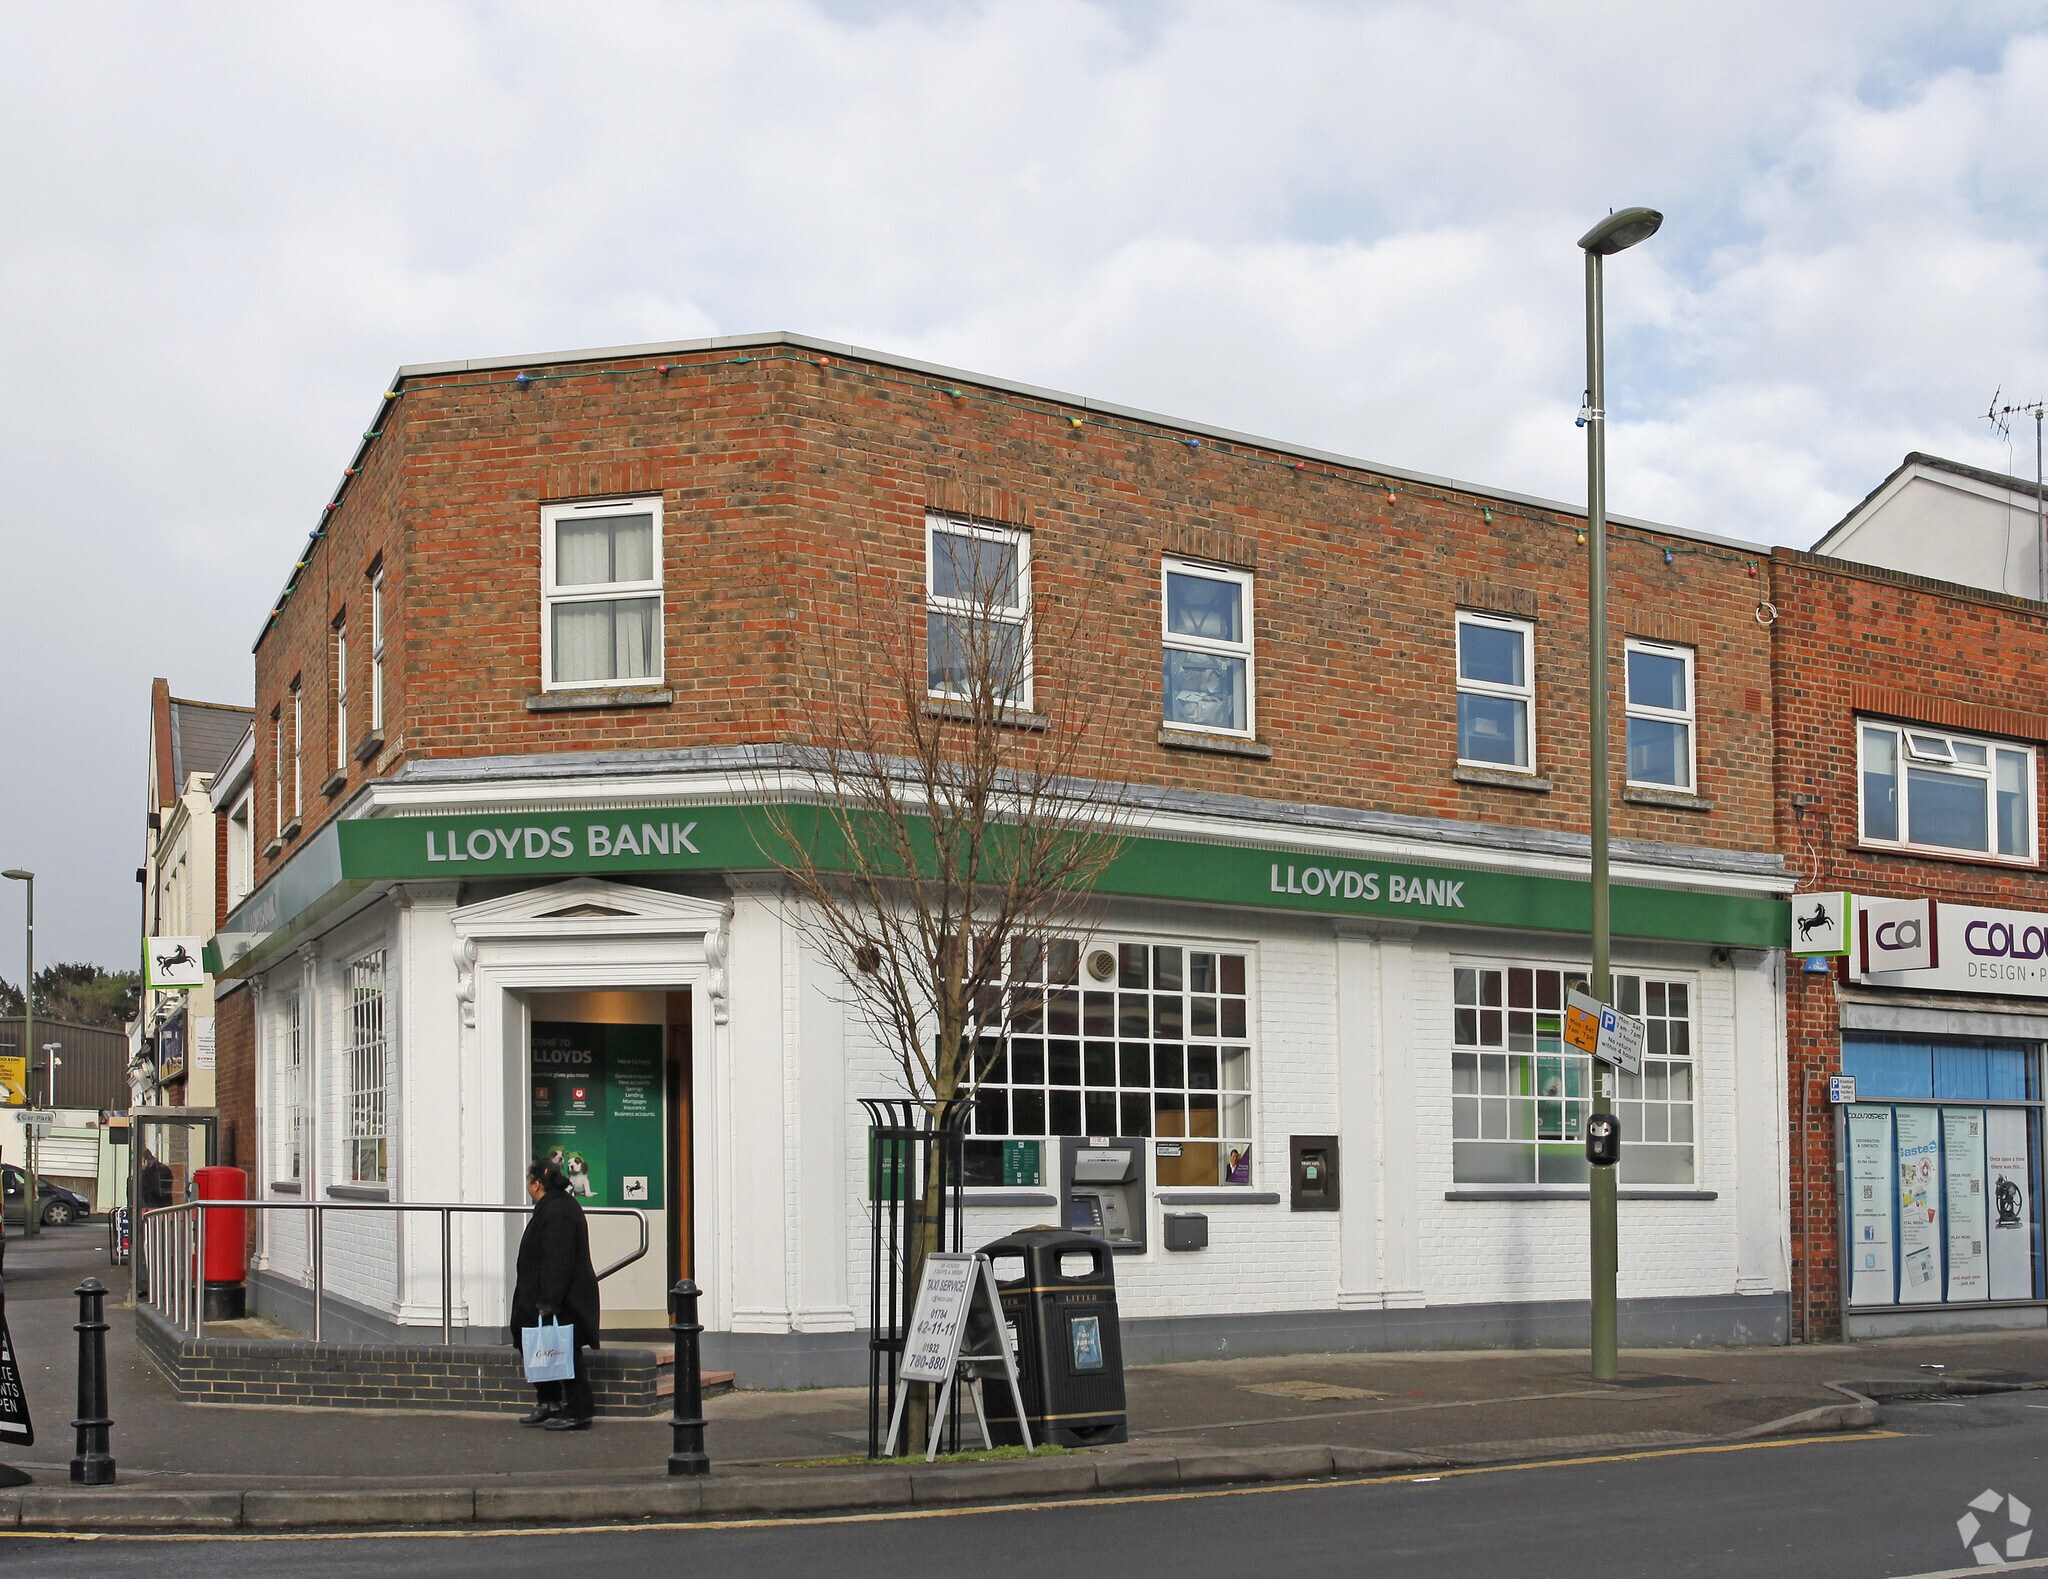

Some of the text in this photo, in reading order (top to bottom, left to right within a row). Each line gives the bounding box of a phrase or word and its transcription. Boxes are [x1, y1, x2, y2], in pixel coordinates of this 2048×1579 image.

[426, 821, 700, 861] LLOYDS BANK
[1271, 863, 1465, 908] LLOYDS BANK
[1968, 962, 2026, 981] DESIGN
[1570, 1018, 1582, 1028] Mon
[1585, 1025, 1594, 1033] Sat
[1618, 1015, 1629, 1025] Mon
[1632, 1022, 1641, 1031] Sat
[532, 1038, 557, 1047] COME
[1608, 1036, 1632, 1052] No return
[1623, 1034, 1637, 1046] hours
[533, 1049, 592, 1064] LLOYDS
[1601, 1042, 1616, 1052] within
[1622, 1050, 1636, 1062] hours
[927, 1279, 966, 1292] TAXI SERVICE
[930, 1308, 948, 1319] 01784
[917, 1320, 956, 1336] 42-11-11
[922, 1342, 940, 1354] 01932
[910, 1354, 946, 1370] 780-880
[0, 1382, 20, 1398] NTS
